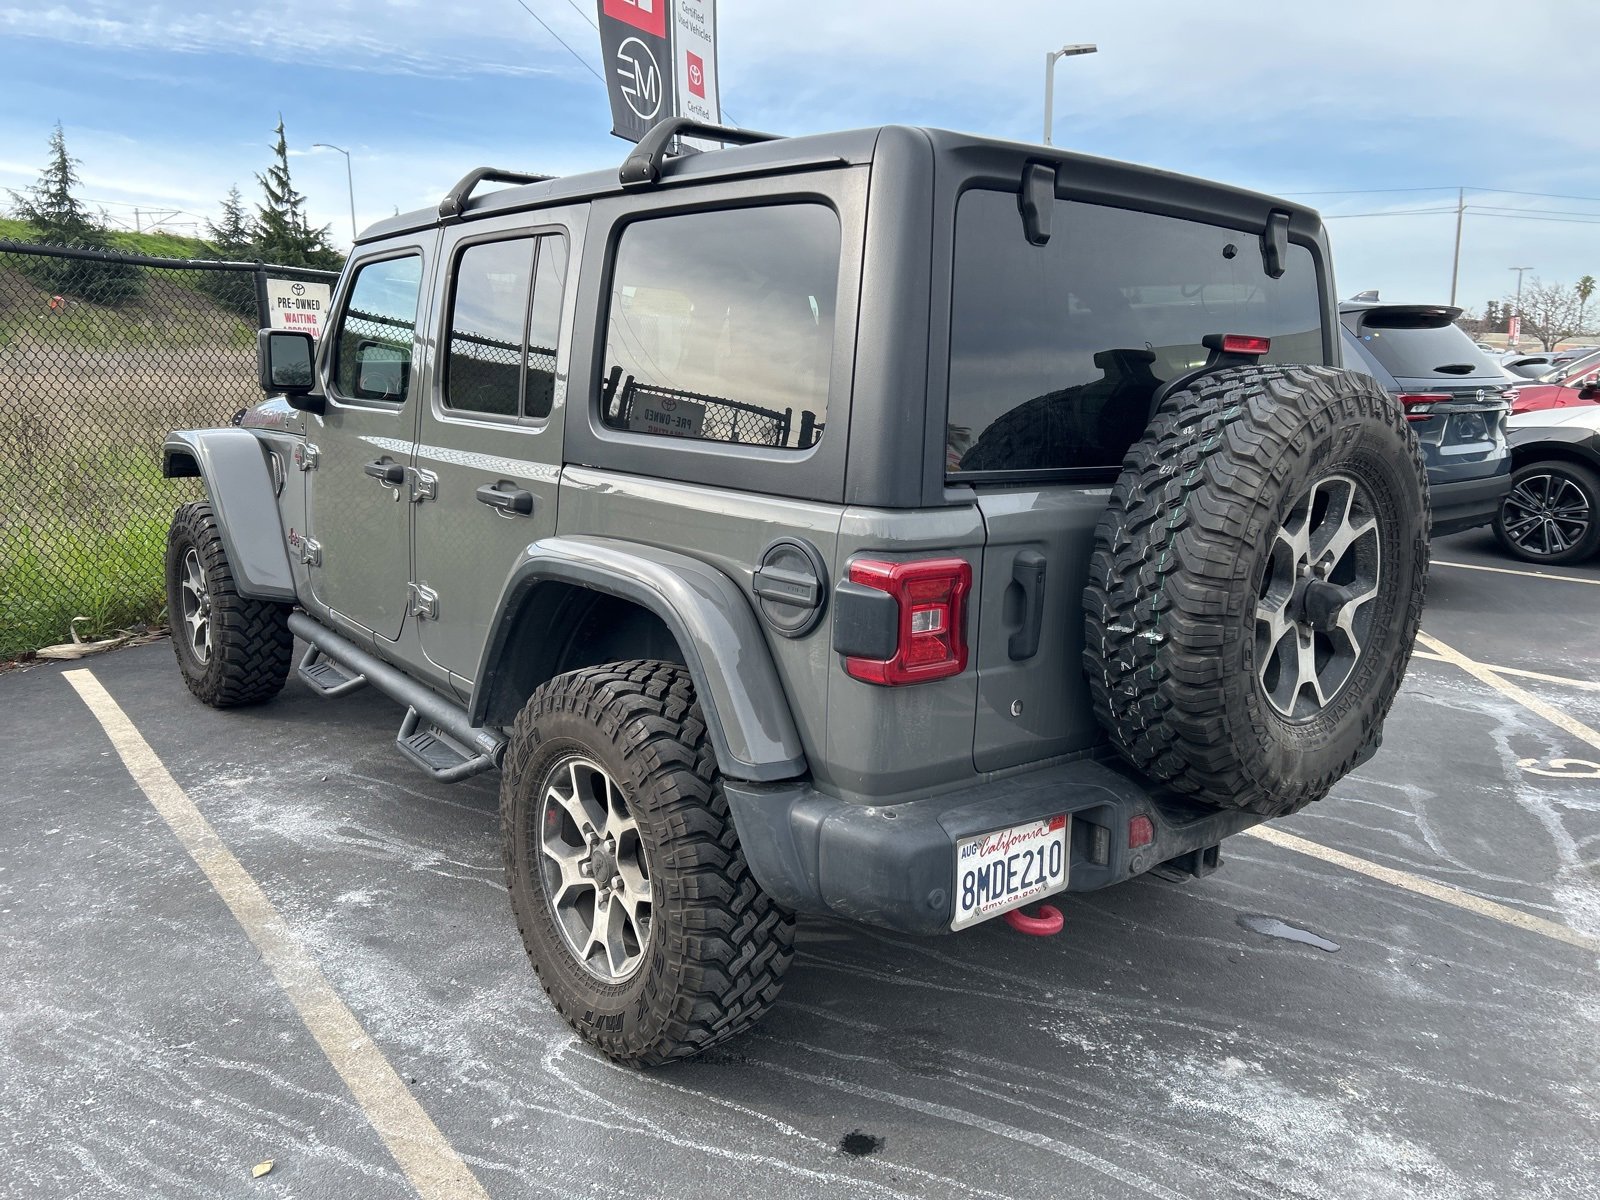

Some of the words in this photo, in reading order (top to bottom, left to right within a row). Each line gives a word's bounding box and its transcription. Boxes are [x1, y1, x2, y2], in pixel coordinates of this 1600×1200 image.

[681, 1, 705, 24] Certified
[678, 15, 690, 31] Used
[689, 21, 712, 43] Vehicles
[687, 100, 710, 120] Certified
[277, 297, 320, 310] PRE-OWNED
[284, 312, 317, 324] WAITING
[961, 842, 977, 859] AUG
[979, 829, 1050, 858] California
[962, 840, 1062, 911] 8MDE210
[982, 885, 1043, 912] dmv.ca.gov
